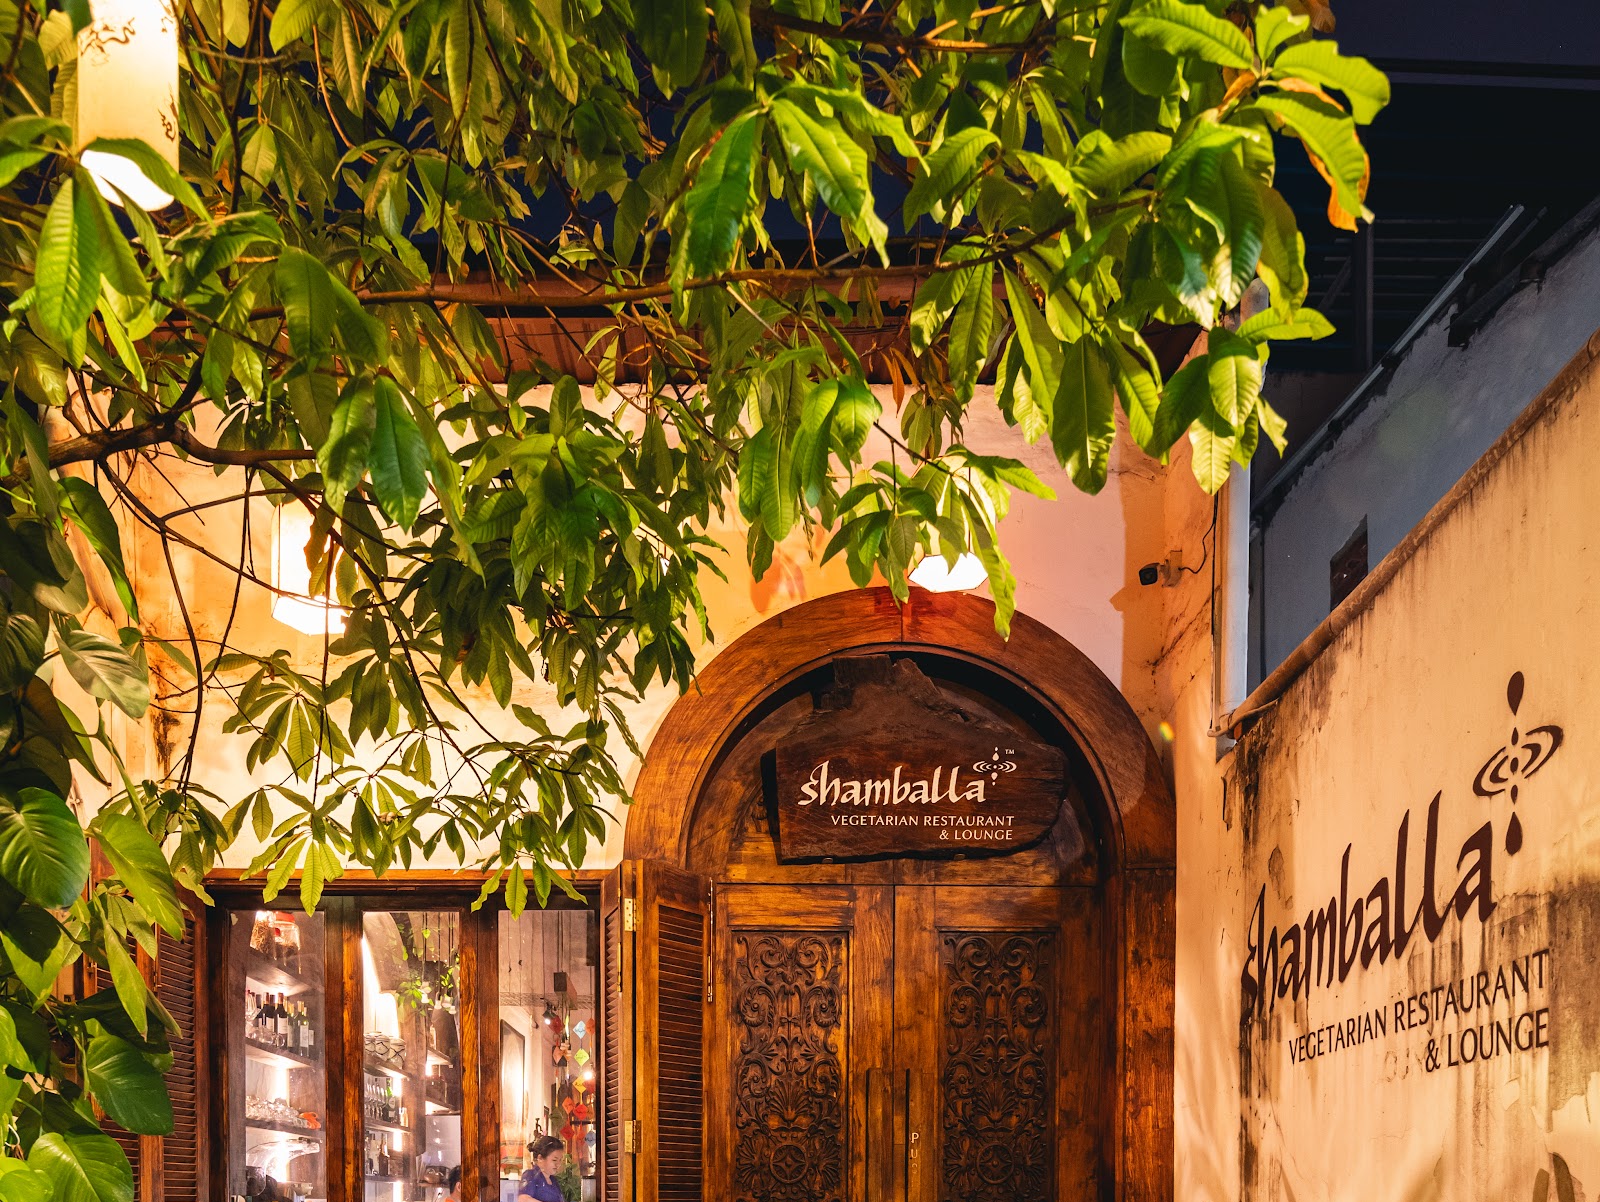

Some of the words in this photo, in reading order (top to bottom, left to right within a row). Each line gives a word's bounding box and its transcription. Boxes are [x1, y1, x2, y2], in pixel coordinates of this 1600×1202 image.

[797, 759, 986, 807] shamballa
[830, 815, 919, 827] VEGETARIAN
[923, 815, 1015, 827] RESTAURANT
[939, 829, 949, 840] &
[954, 829, 1013, 840] LOUNGE
[1239, 789, 1499, 1028] shamballa
[1288, 1005, 1388, 1066] VEGETARIAN
[1393, 948, 1550, 1033] RESTAURANT
[1424, 1038, 1442, 1073] &
[1446, 1007, 1550, 1067] LOUNGE
